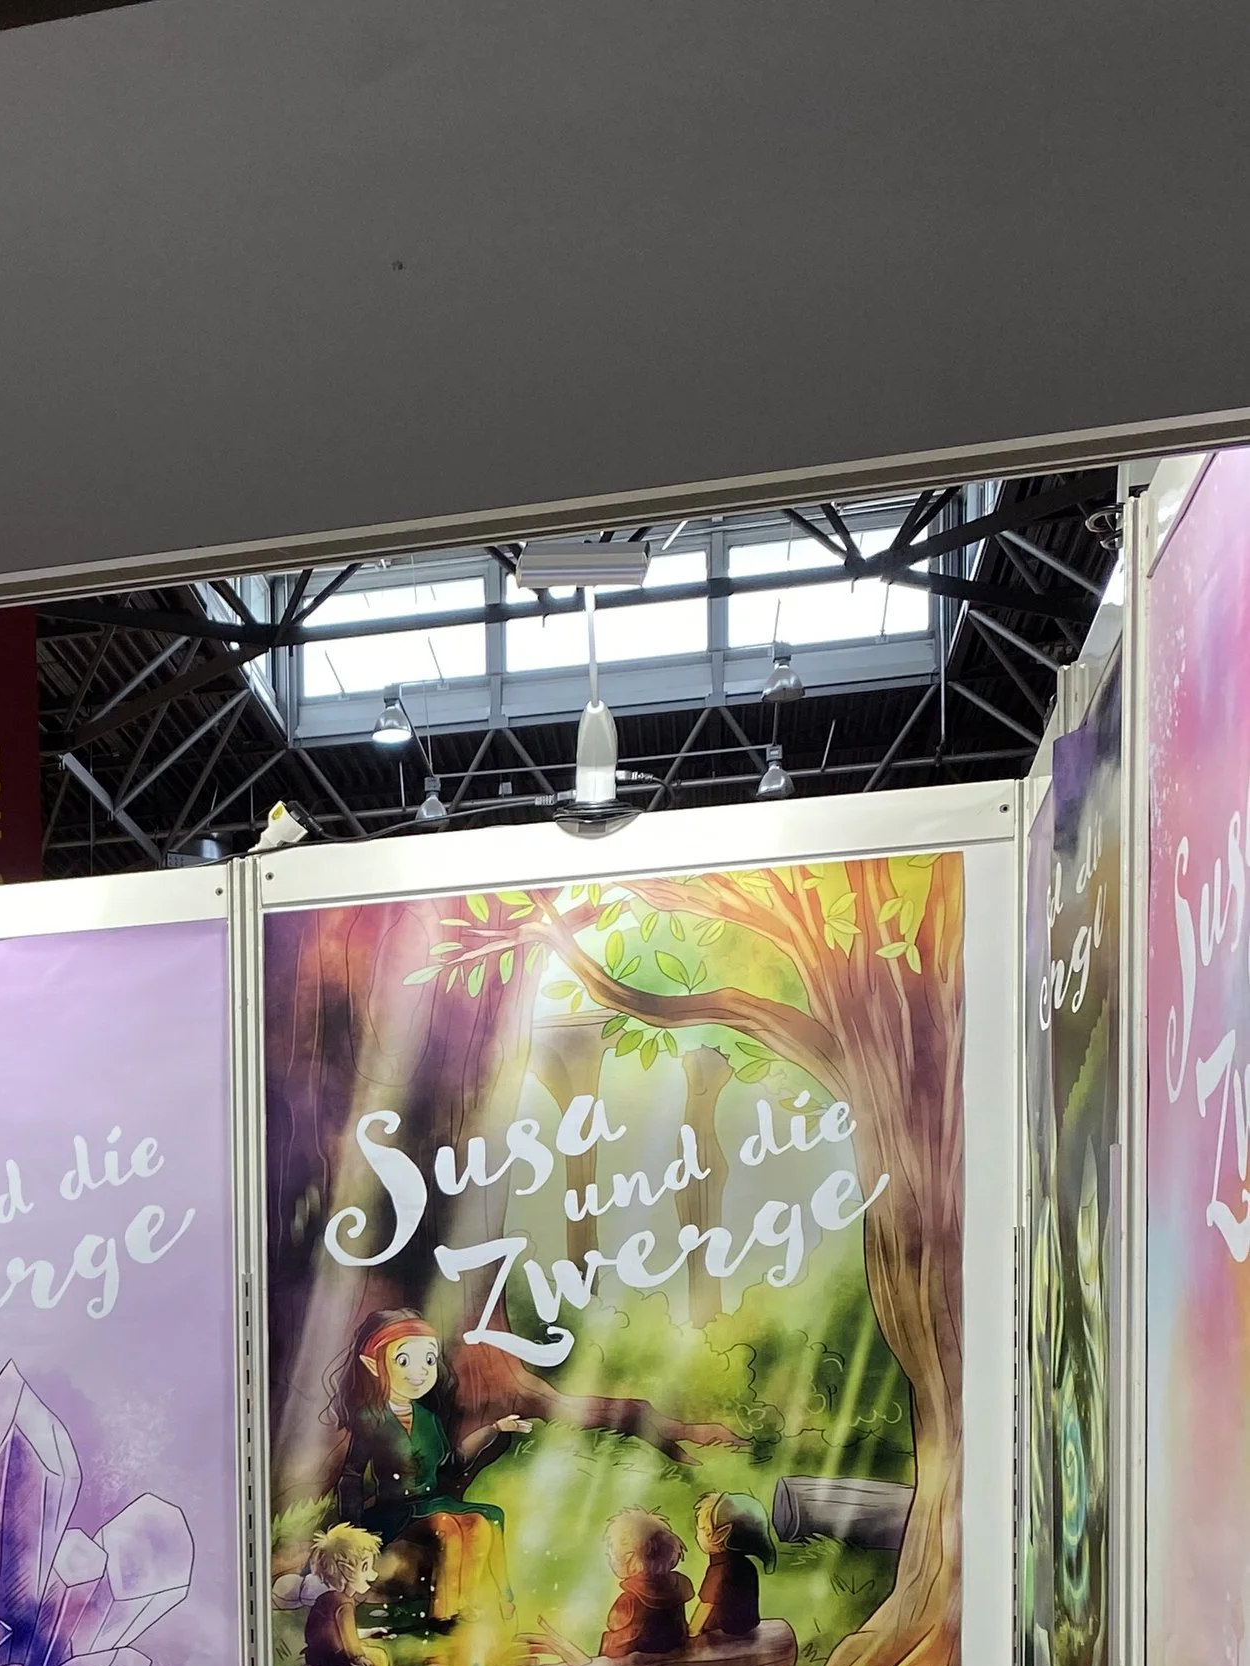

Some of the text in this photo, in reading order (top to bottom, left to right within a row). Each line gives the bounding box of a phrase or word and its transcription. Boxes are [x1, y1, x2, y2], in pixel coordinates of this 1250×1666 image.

[1165, 790, 1250, 1103] Sus
[59, 1126, 164, 1200] die
[324, 1094, 626, 1267] Susa
[564, 1090, 857, 1221] und die
[434, 1170, 890, 1367] Zwerge
